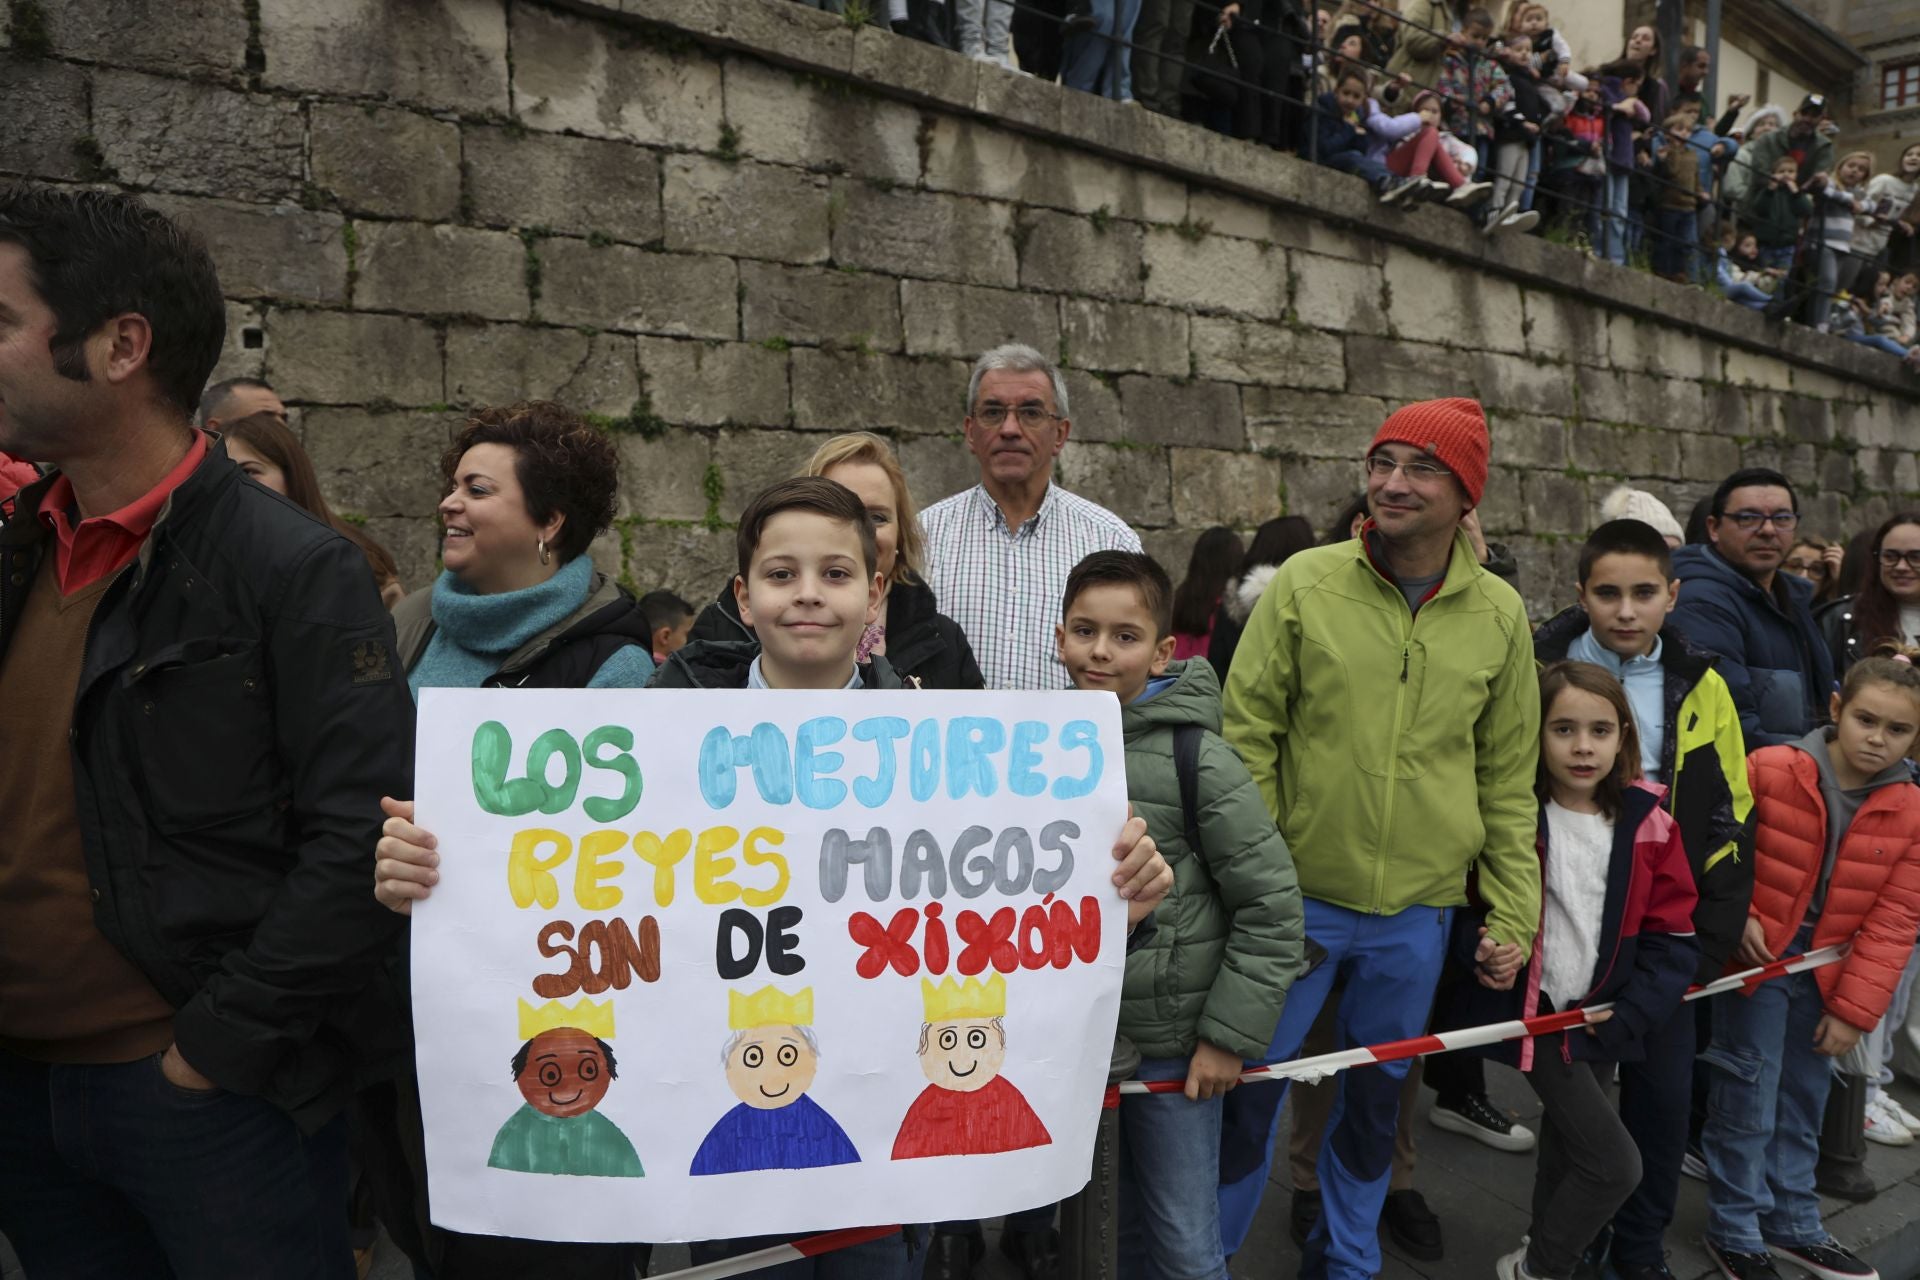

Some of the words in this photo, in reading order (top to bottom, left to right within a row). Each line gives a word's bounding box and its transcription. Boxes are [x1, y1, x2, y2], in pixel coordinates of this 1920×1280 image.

[471, 720, 643, 823] LOS
[698, 716, 1104, 810] MEJORES
[507, 825, 790, 909] REYES
[819, 819, 1081, 904] MAGOS
[532, 915, 661, 999] SON
[715, 905, 806, 980] DE
[847, 892, 1102, 980] XIXÓN
